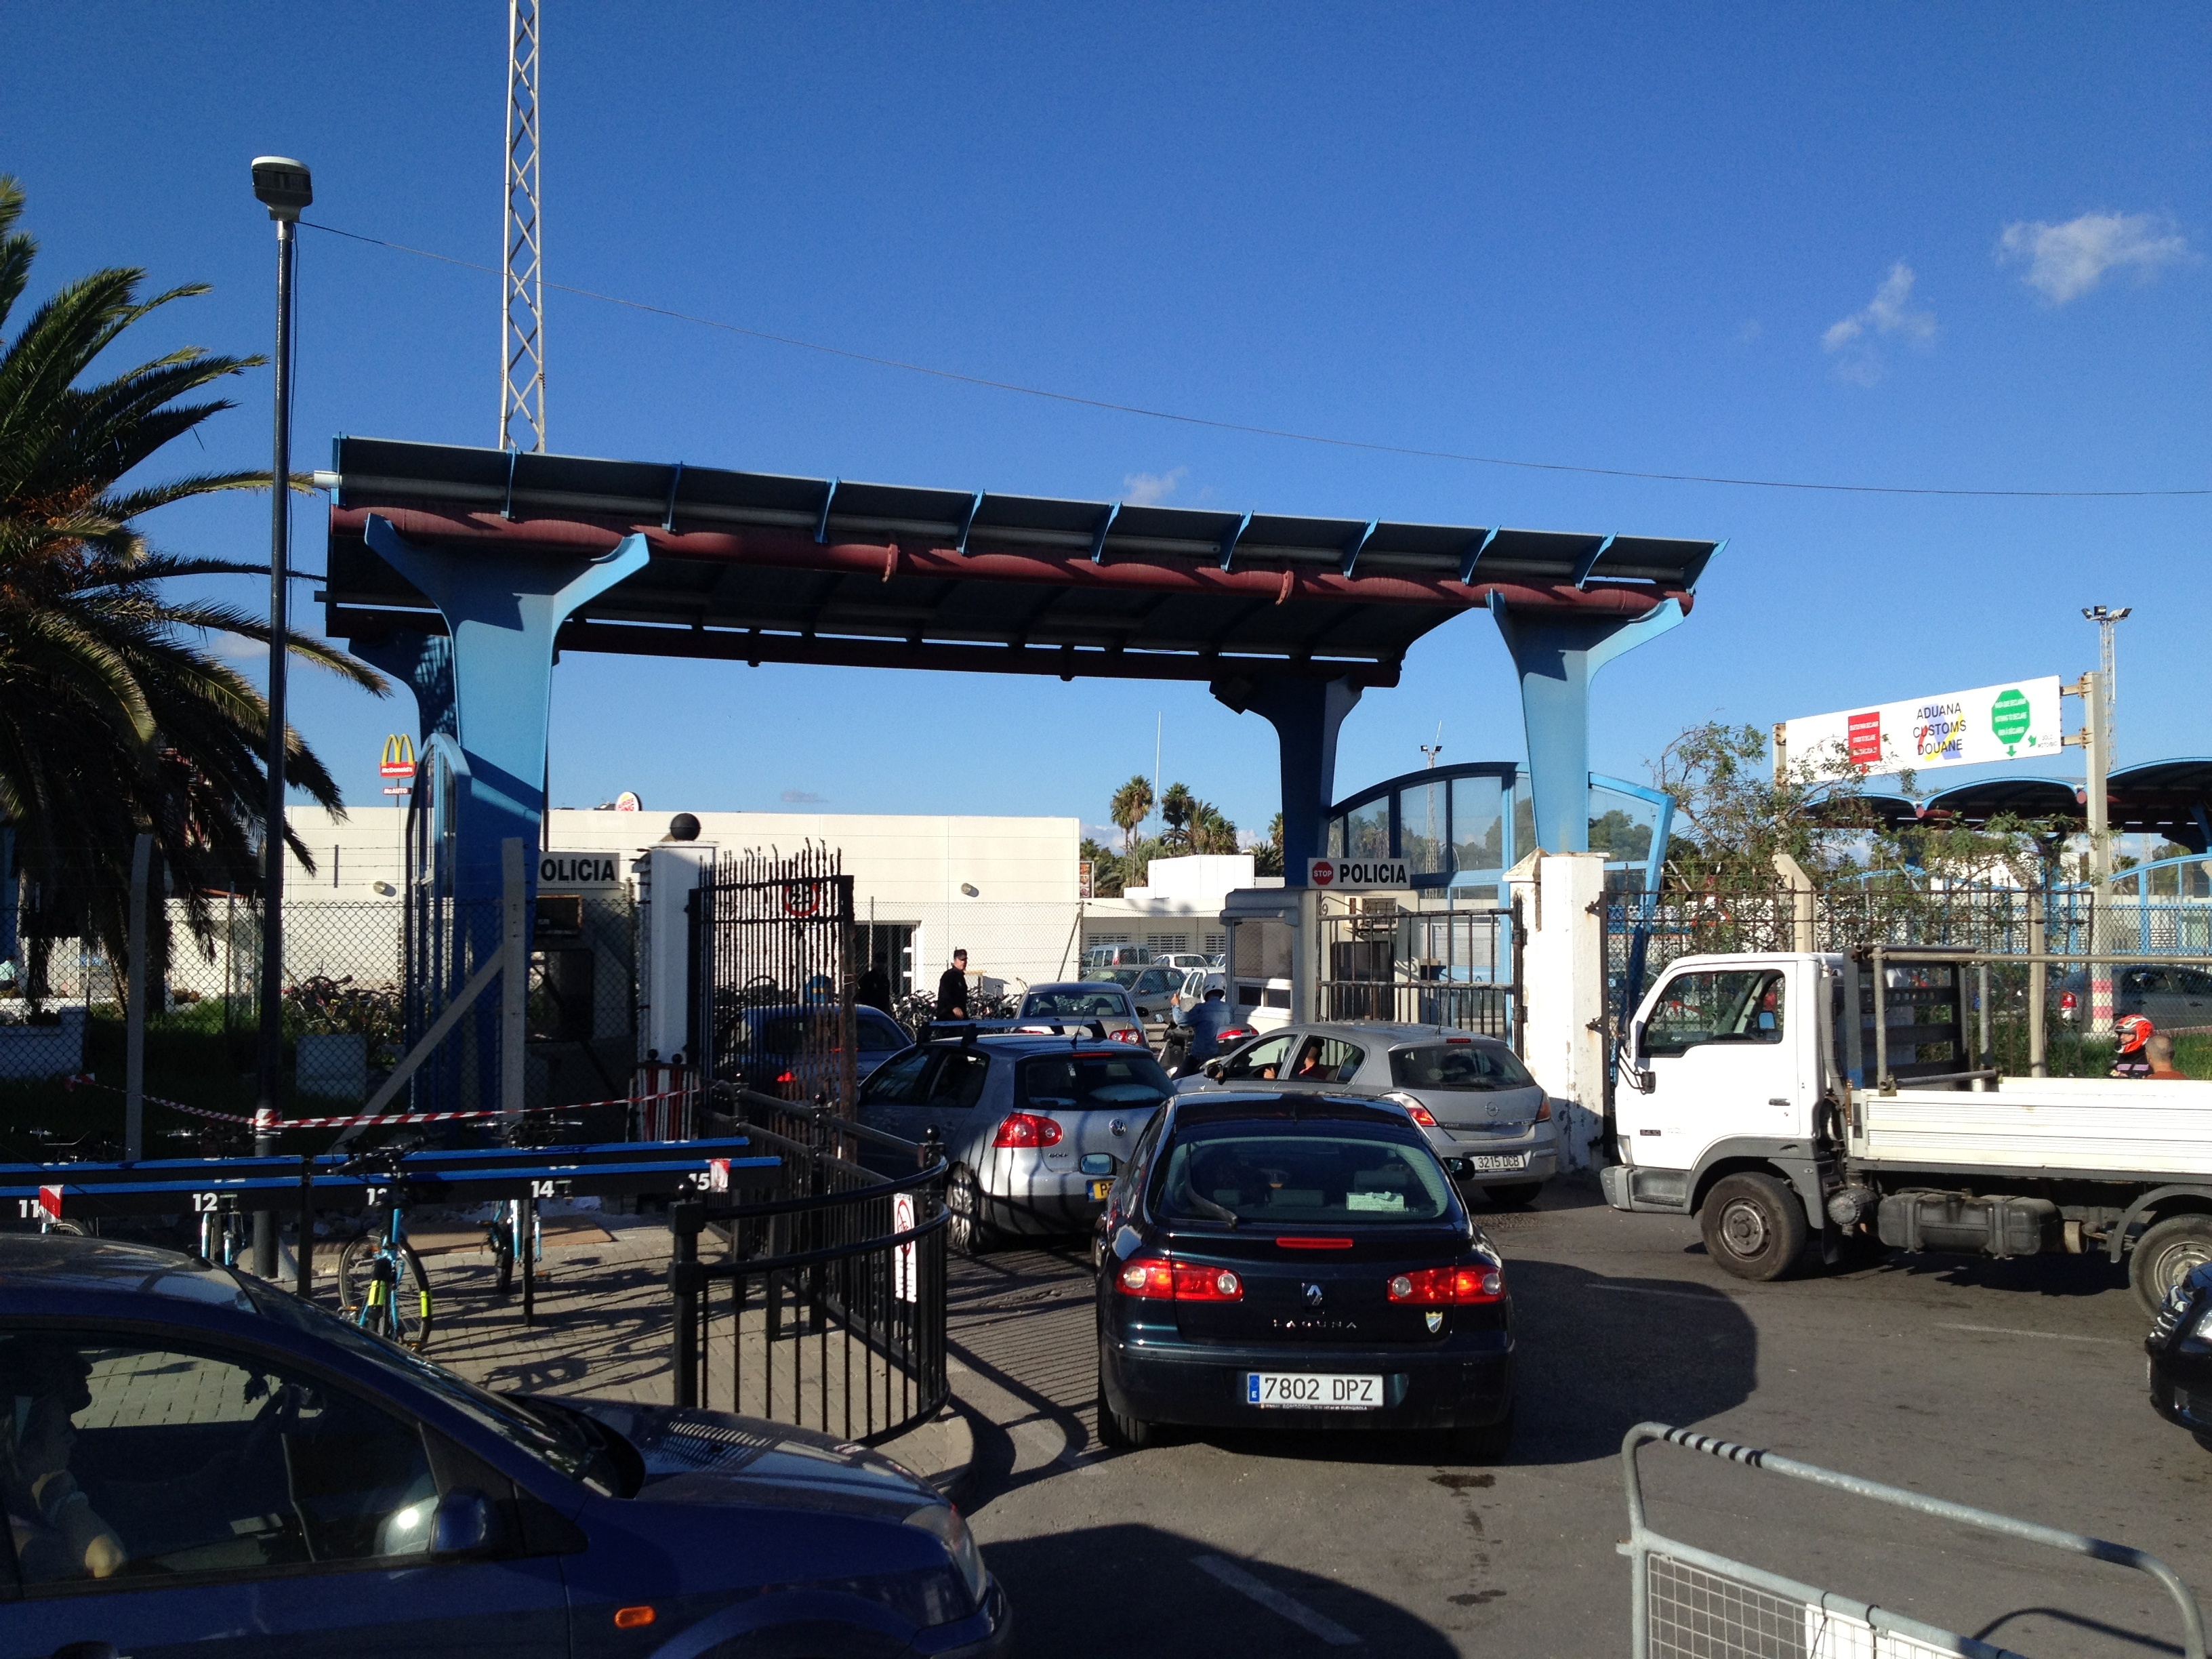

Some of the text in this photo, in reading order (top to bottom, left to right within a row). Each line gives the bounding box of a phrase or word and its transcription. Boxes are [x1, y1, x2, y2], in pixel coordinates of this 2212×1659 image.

[1917, 702, 1962, 720] ADUANA
[1913, 720, 1967, 738] CUSTOMS
[1917, 739, 1963, 756] DOUANE
[541, 859, 616, 881] OLICIA
[1339, 863, 1407, 883] POLICIA
[1478, 1157, 1501, 1168] 3215
[531, 1181, 554, 1198] 14
[19, 1200, 39, 1218] 11
[192, 1193, 218, 1212] 12
[1265, 1377, 1373, 1401] 7802 DPZ
